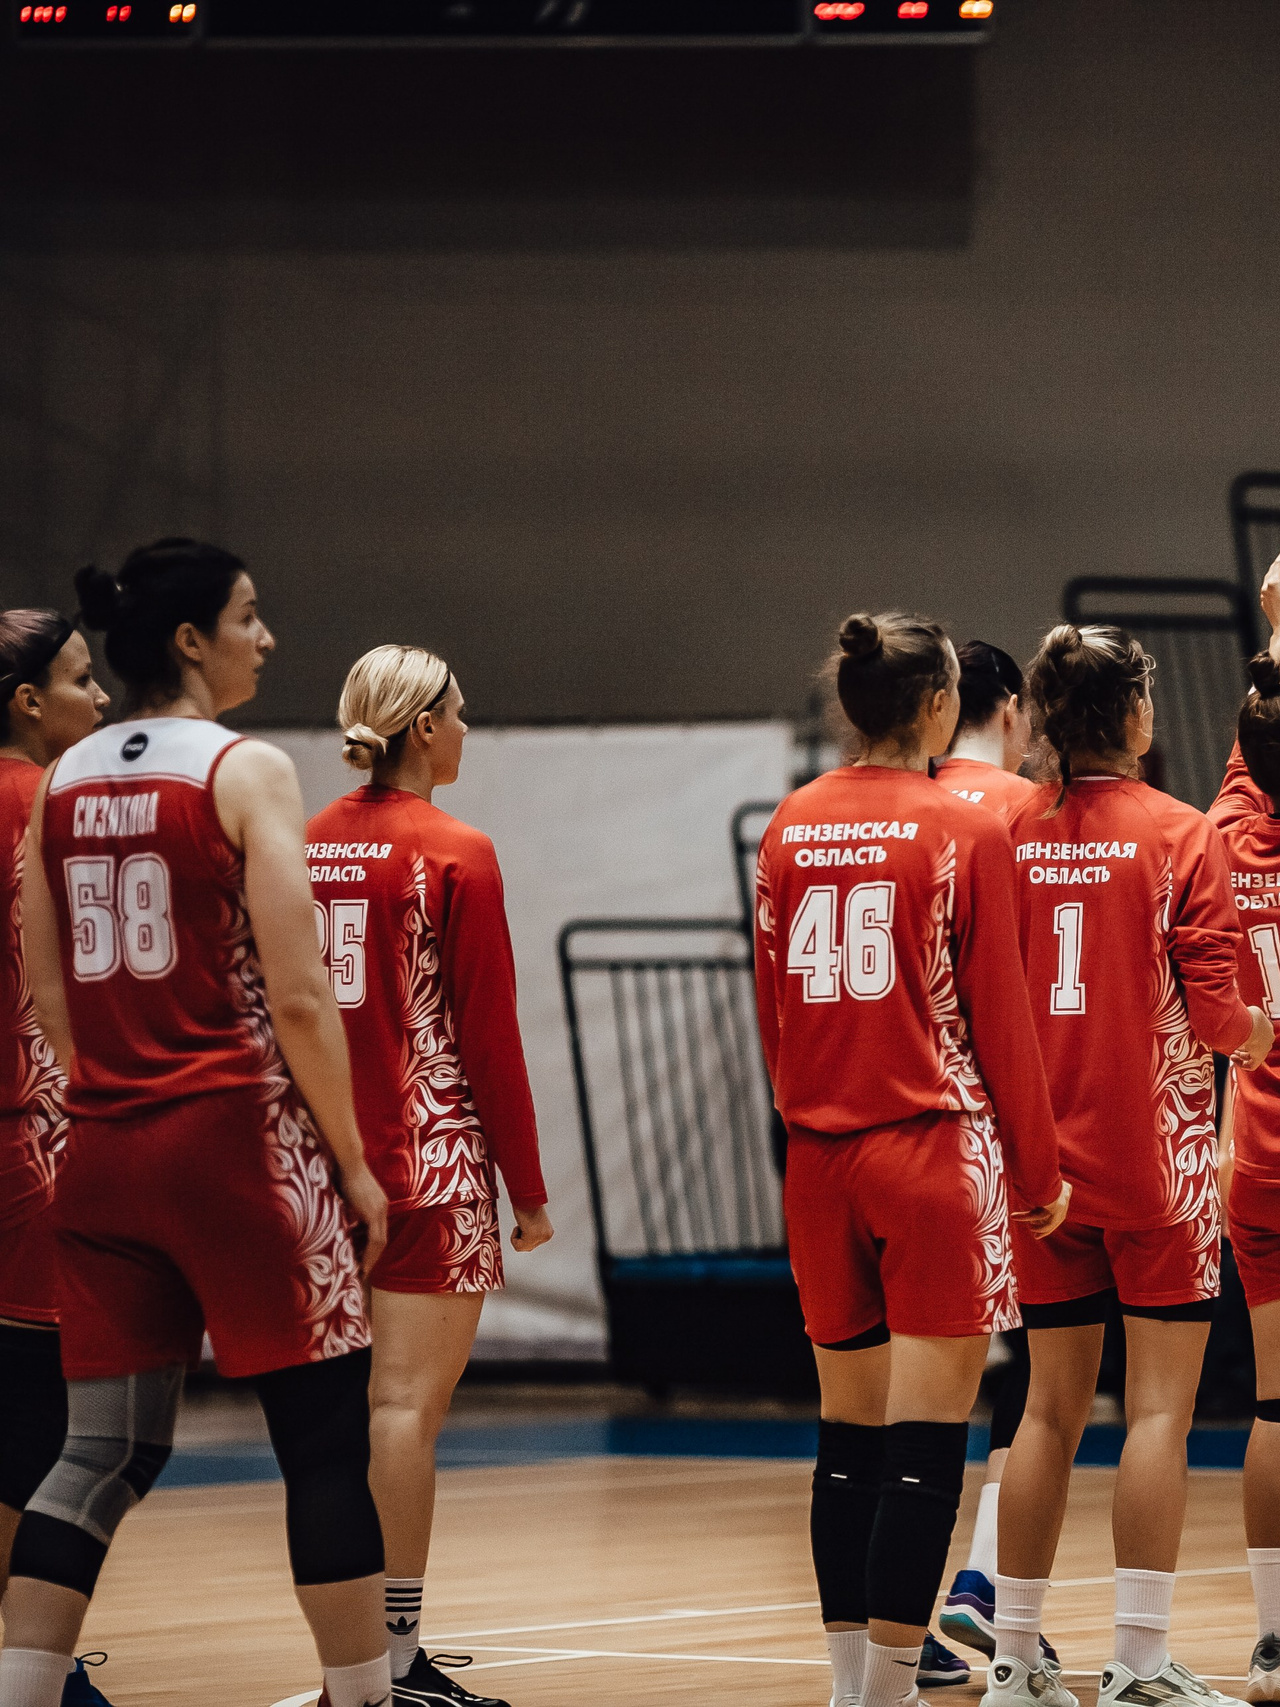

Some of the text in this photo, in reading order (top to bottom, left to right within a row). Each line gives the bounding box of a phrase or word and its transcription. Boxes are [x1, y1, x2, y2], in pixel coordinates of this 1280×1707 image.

[782, 821, 919, 844] ПЕНЗЕНСКАЯ
[304, 843, 393, 859] НЗЕНСКАЯ
[794, 845, 887, 868] ОБЛАСТЬ
[1016, 841, 1138, 863] ПЕНЗЕНСКАЯ
[307, 865, 366, 882] БЛАСТЬ
[1029, 865, 1111, 885] ОБЛАСТЬ
[63, 852, 179, 983] 58
[787, 880, 896, 1004] 46
[1050, 902, 1086, 1015] 1
